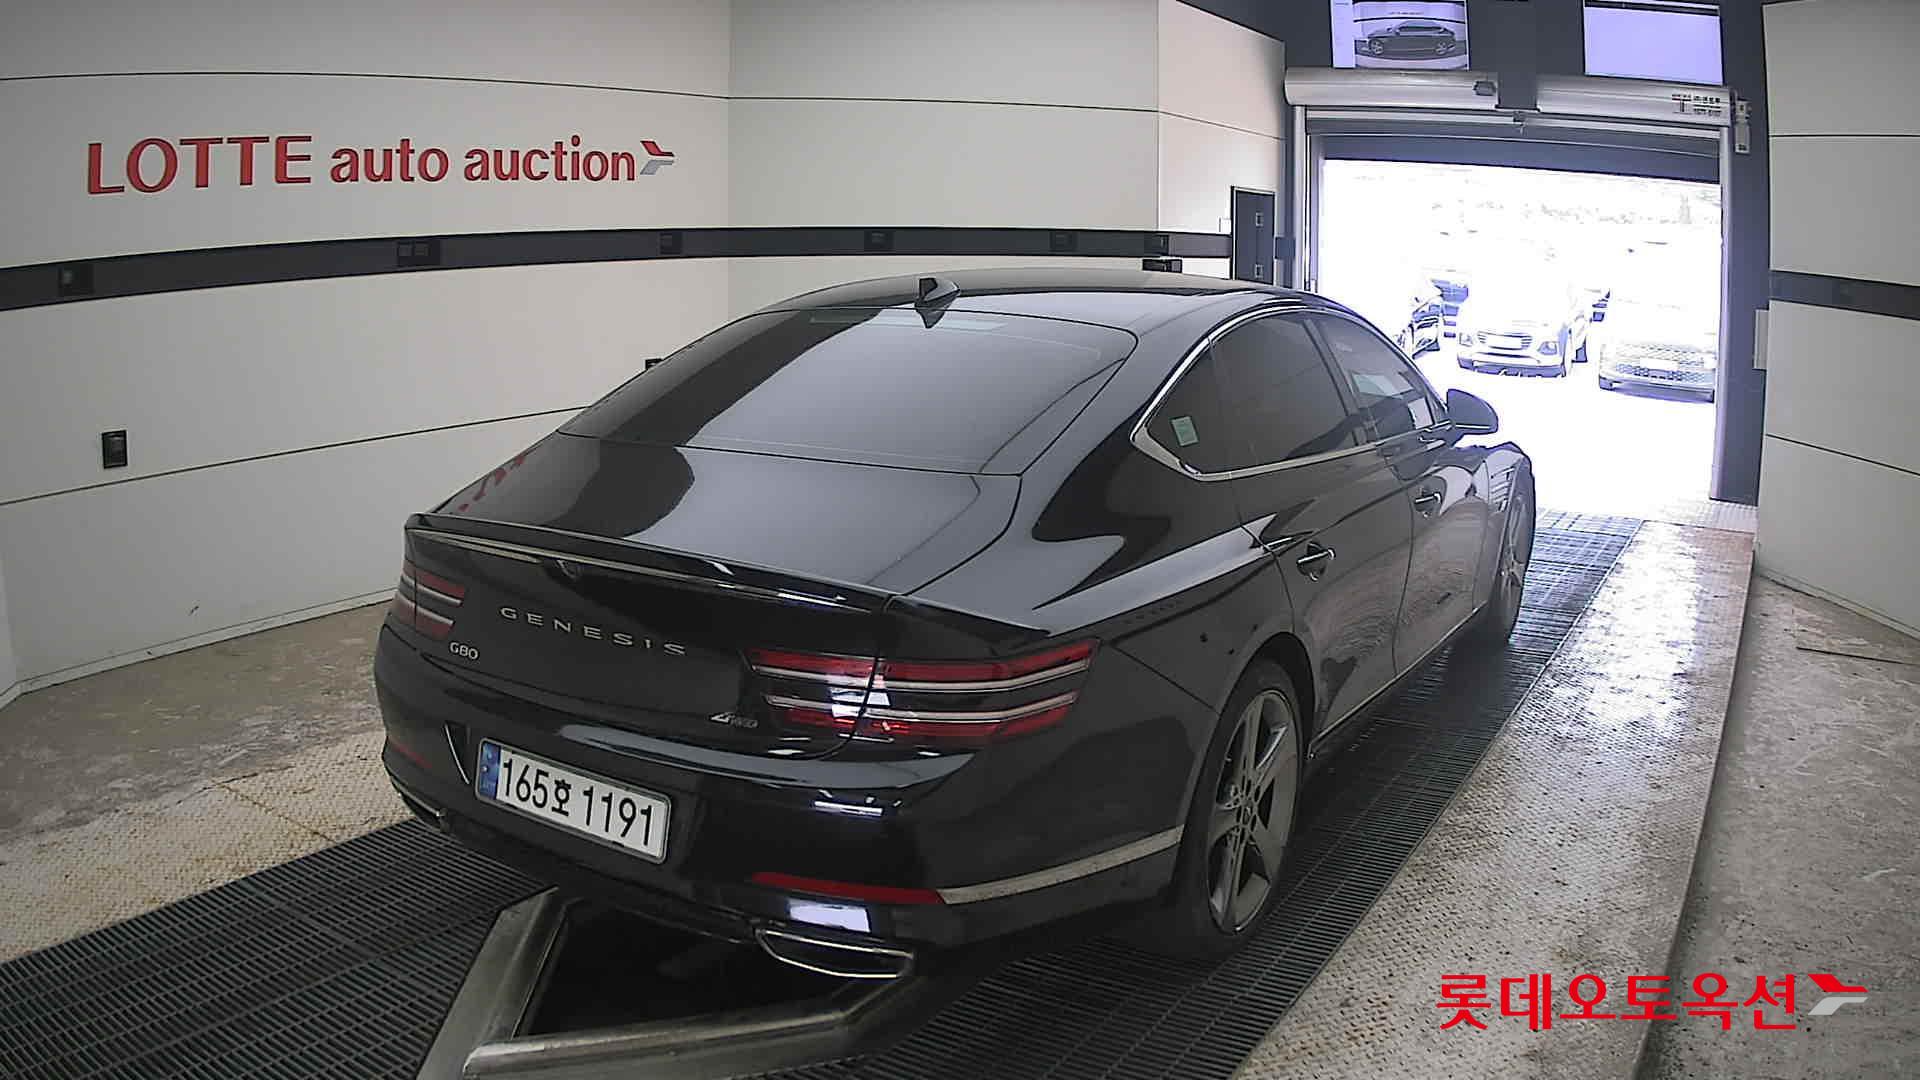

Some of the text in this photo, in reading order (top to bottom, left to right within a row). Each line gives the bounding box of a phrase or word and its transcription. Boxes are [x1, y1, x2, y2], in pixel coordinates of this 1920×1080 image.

[88, 134, 636, 194] LOTTE auto auction
[449, 641, 480, 661] G80
[500, 607, 686, 656] GENESIS
[503, 758, 653, 846] 165호 1191
